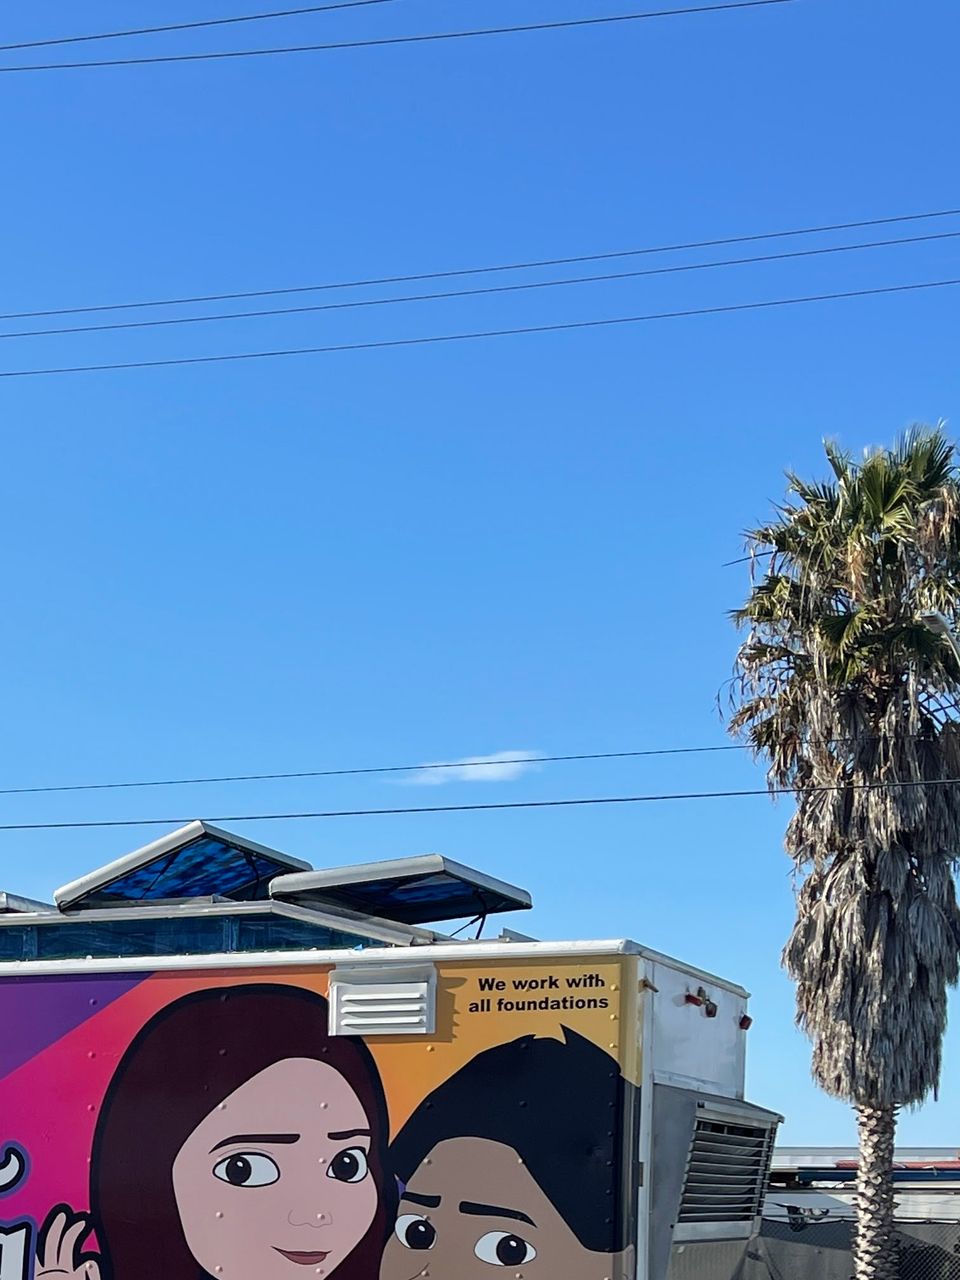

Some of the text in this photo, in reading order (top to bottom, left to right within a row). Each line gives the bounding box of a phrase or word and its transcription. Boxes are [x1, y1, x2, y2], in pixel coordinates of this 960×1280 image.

[478, 974, 605, 991] We work with
[469, 996, 609, 1013] all foundations
